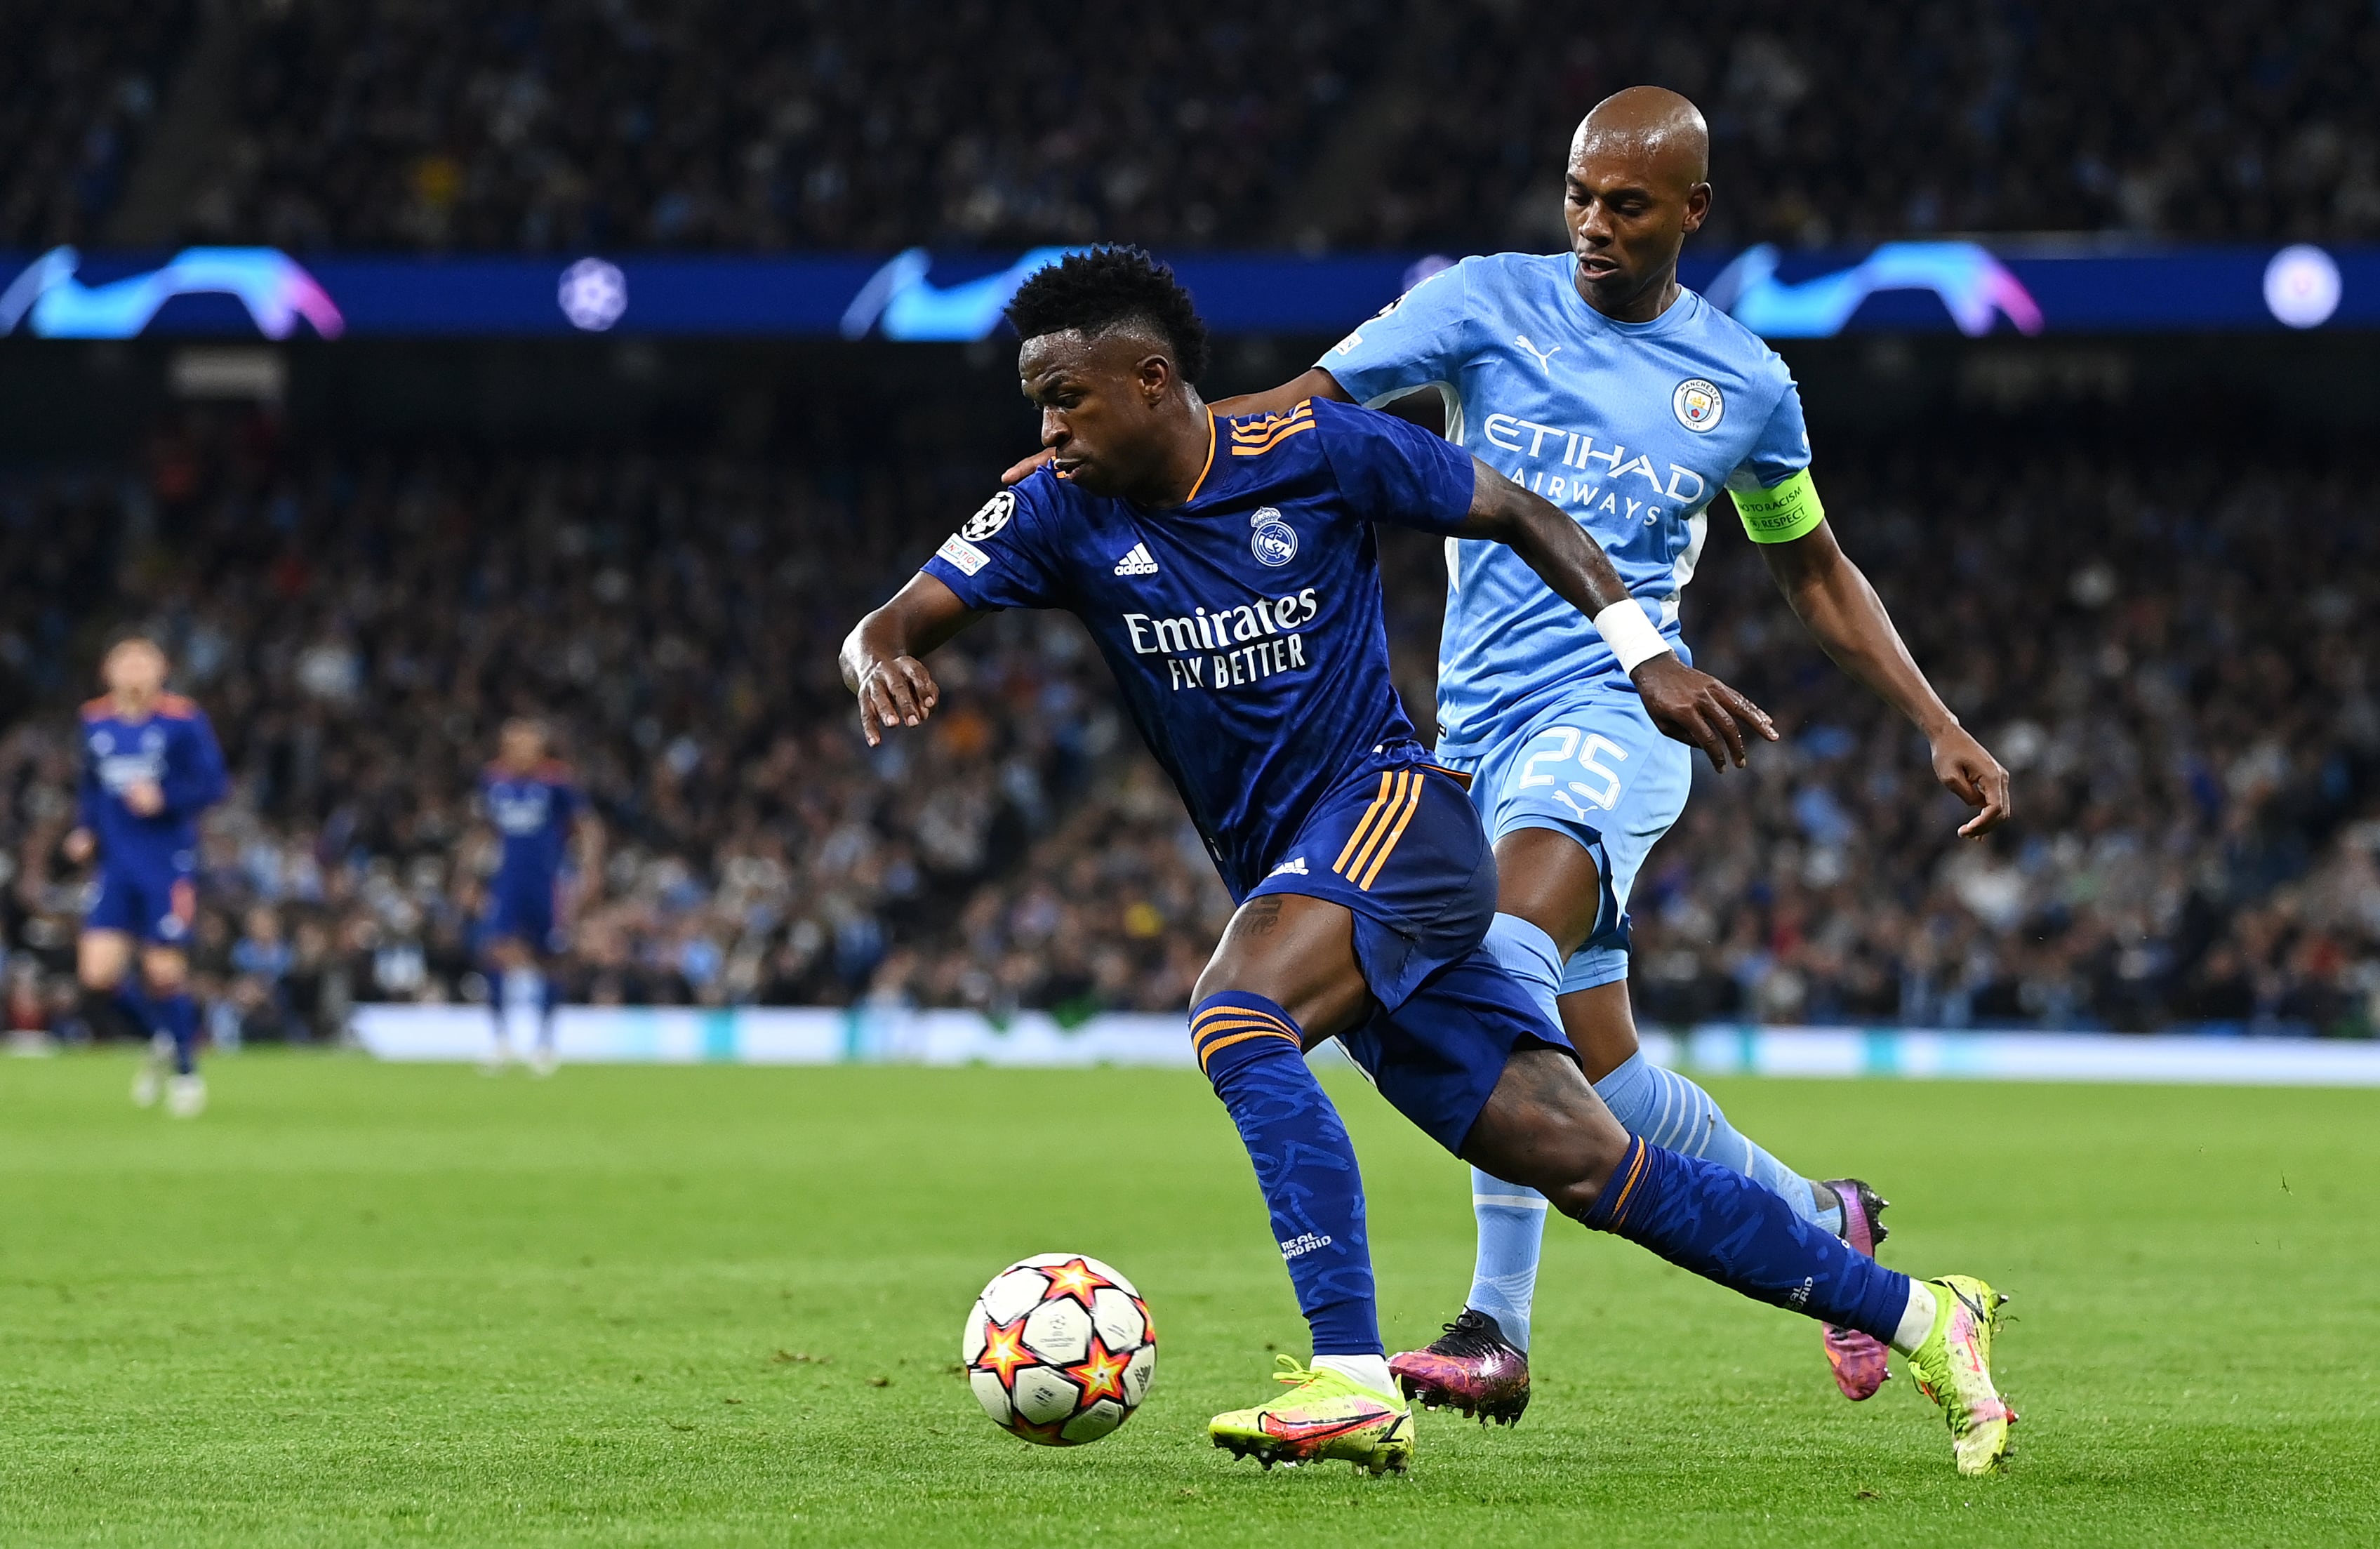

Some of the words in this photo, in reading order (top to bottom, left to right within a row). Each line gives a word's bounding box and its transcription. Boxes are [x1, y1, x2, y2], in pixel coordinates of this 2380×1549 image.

[1680, 381, 1720, 406] MANCHESTER
[1685, 420, 1700, 429] CITY
[1484, 413, 1705, 504] ETIHAD
[1510, 467, 1661, 526] AIRWAYS
[1751, 504, 1763, 512] TO
[1764, 486, 1802, 512] RACISM
[1761, 505, 1805, 528] RESPECT
[1114, 562, 1159, 576] adidas
[1123, 587, 1317, 654] Emirates
[1167, 657, 1204, 691] FLY
[1213, 633, 1306, 689] BETTER
[1518, 726, 1629, 811] 25
[1281, 1232, 1319, 1251] REAL
[1282, 1235, 1332, 1260] MADRID
